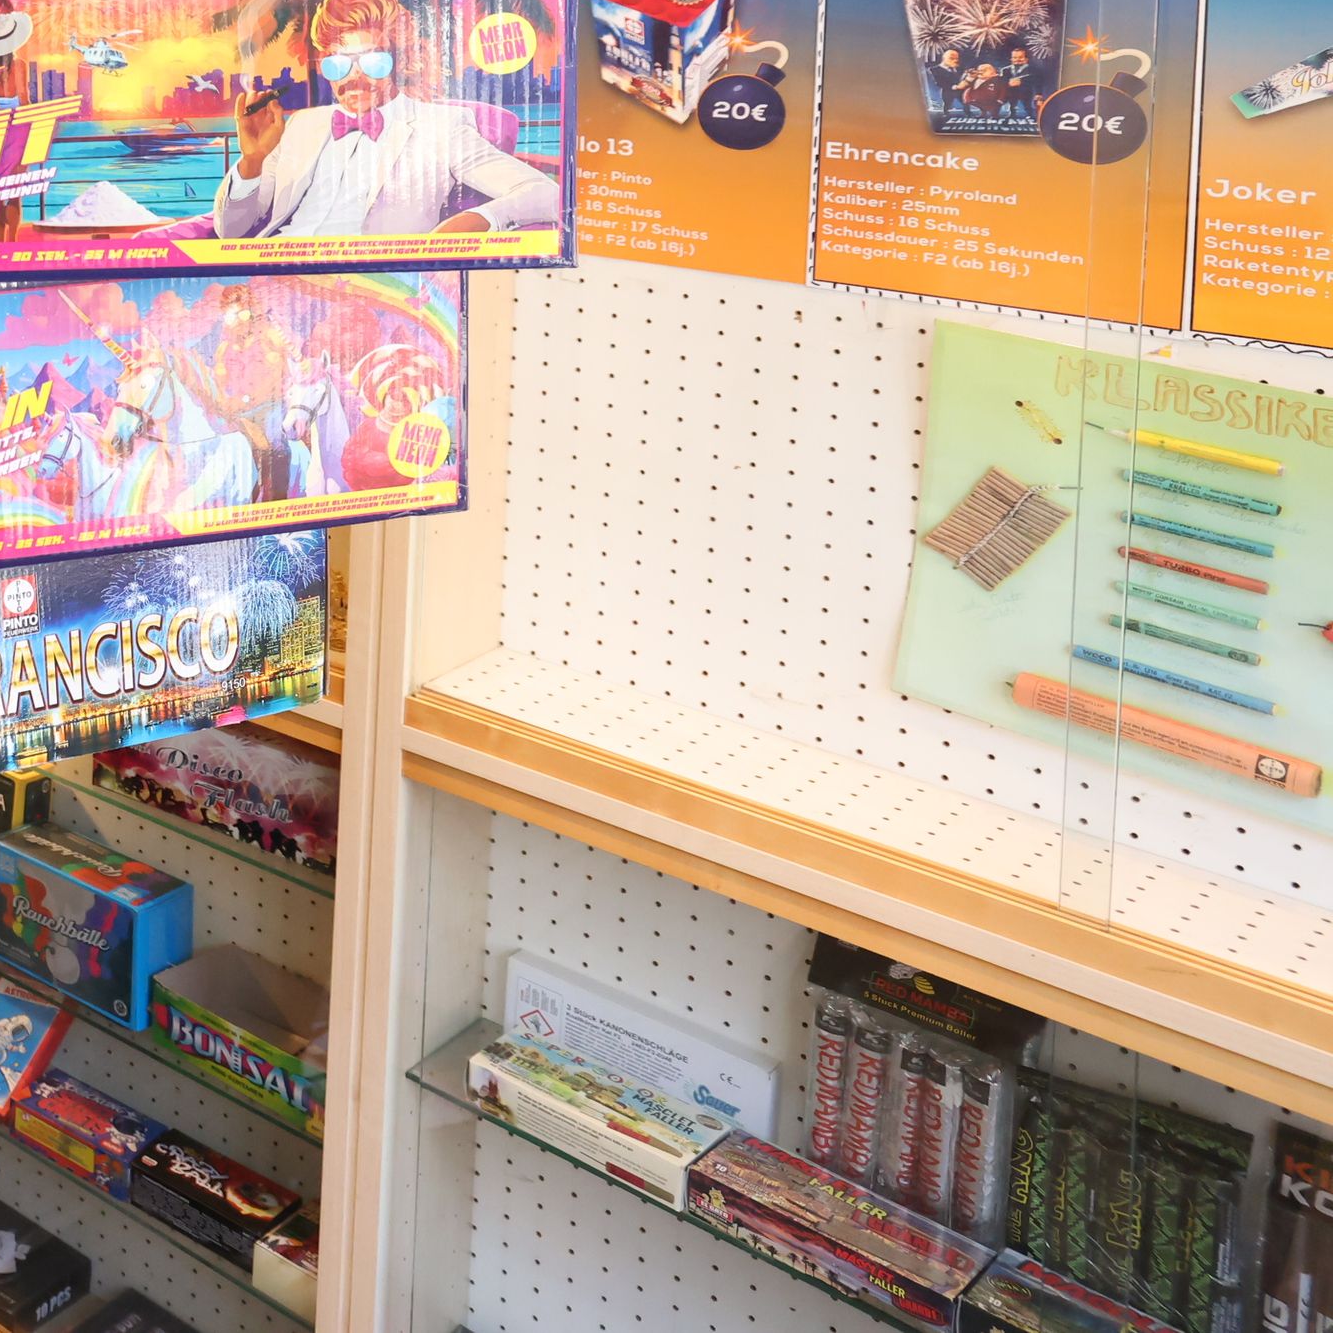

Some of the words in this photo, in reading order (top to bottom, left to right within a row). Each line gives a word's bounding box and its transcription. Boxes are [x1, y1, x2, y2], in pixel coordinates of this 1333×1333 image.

[479, 20, 524, 43] MEHR
[711, 100, 769, 123] 20€
[825, 140, 980, 172] Ehrencake
[610, 169, 653, 186] Pinto
[587, 184, 638, 201] 30mm
[1204, 178, 1317, 206] Joker
[1204, 217, 1325, 241] Hersteller
[821, 224, 939, 247] Schussdauer
[983, 241, 1084, 266] Sekunden
[1201, 272, 1317, 298] Kategorie
[402, 421, 442, 444] MEHR
[395, 442, 440, 468] NEON
[1163, 560, 1201, 578] TURBO
[2, 611, 39, 632] PINTO
[154, 745, 245, 787] Disco
[187, 781, 296, 826] Flash
[13, 896, 110, 952] Rauchbälle
[910, 991, 971, 1025] MAMBA
[597, 1018, 690, 1065] KANONENSCHLÄGE
[169, 1009, 311, 1112] BONSAI
[632, 1093, 697, 1128] MASCLET
[692, 1085, 741, 1117] Sauer
[644, 1108, 695, 1136] FALLER
[808, 1176, 889, 1219] FALLER
